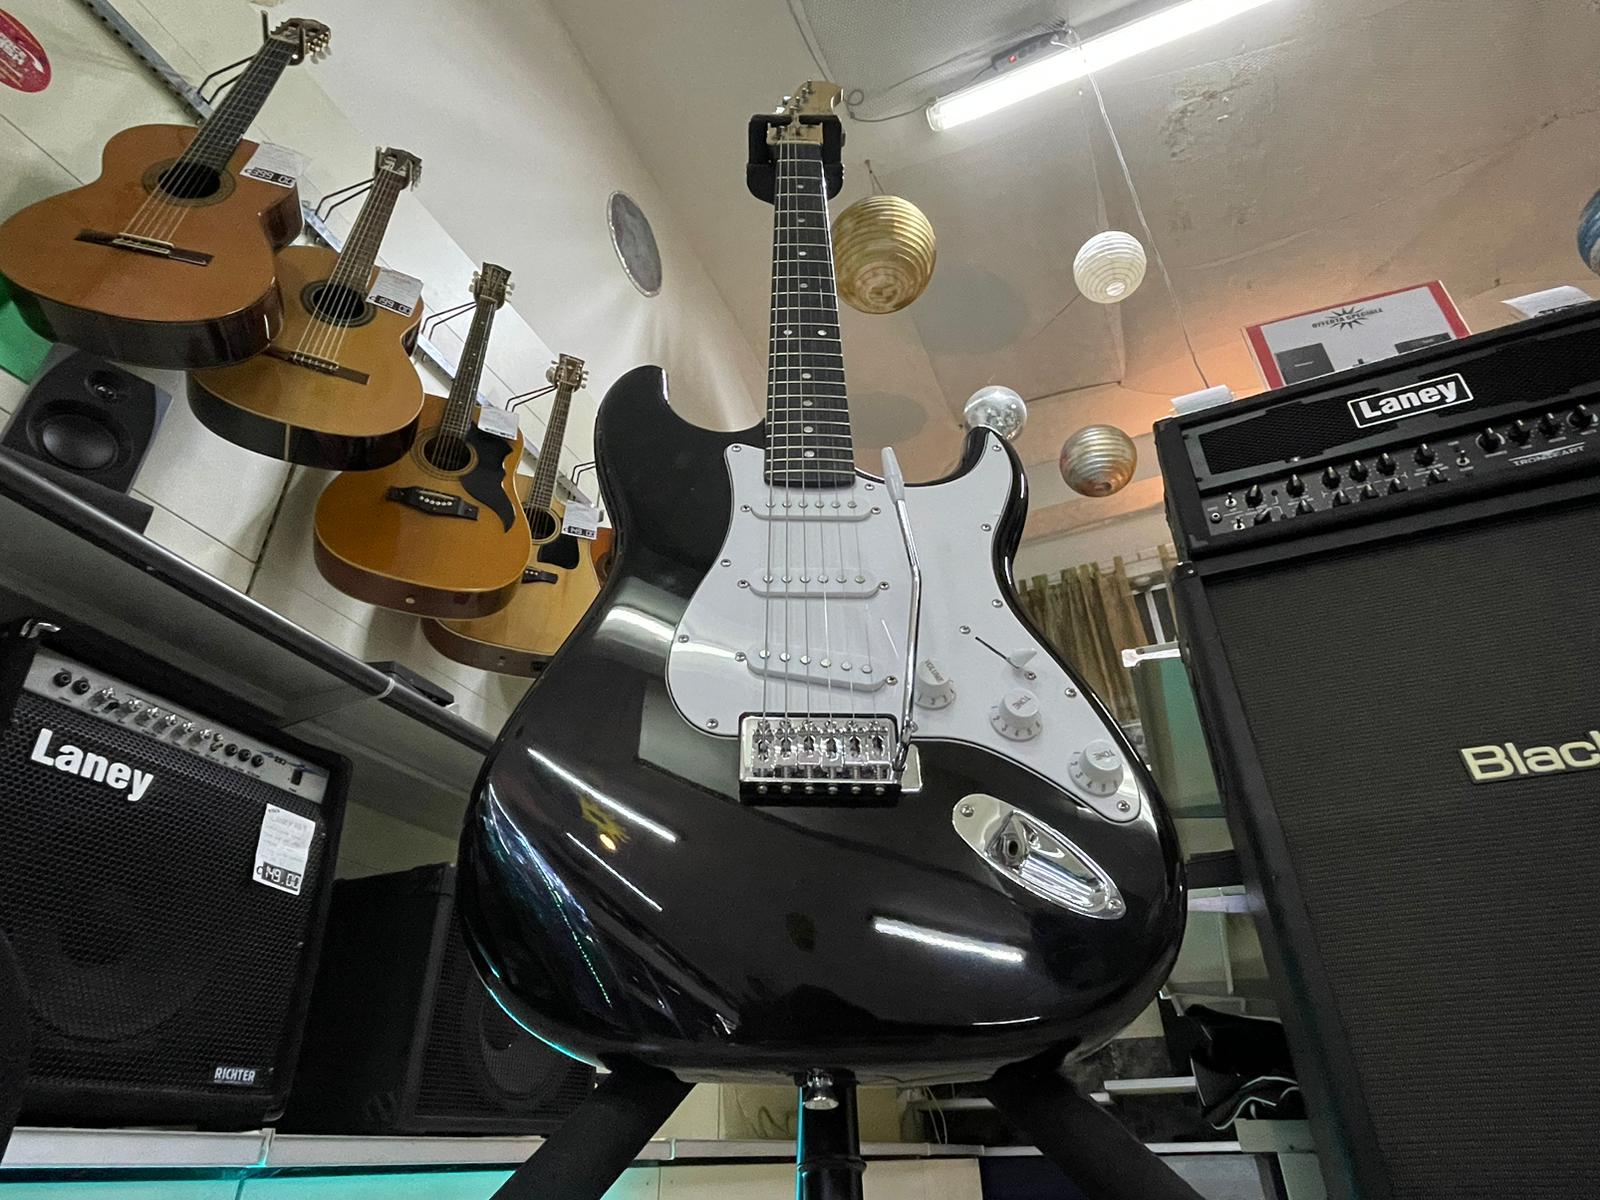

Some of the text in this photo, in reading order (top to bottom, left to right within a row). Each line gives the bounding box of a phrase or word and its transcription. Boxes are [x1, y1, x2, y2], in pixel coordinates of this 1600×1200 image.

[1358, 381, 1457, 419] Laney
[31, 727, 154, 802] Laney
[1461, 730, 1600, 781] Blac
[214, 1066, 256, 1082] RICHTER
